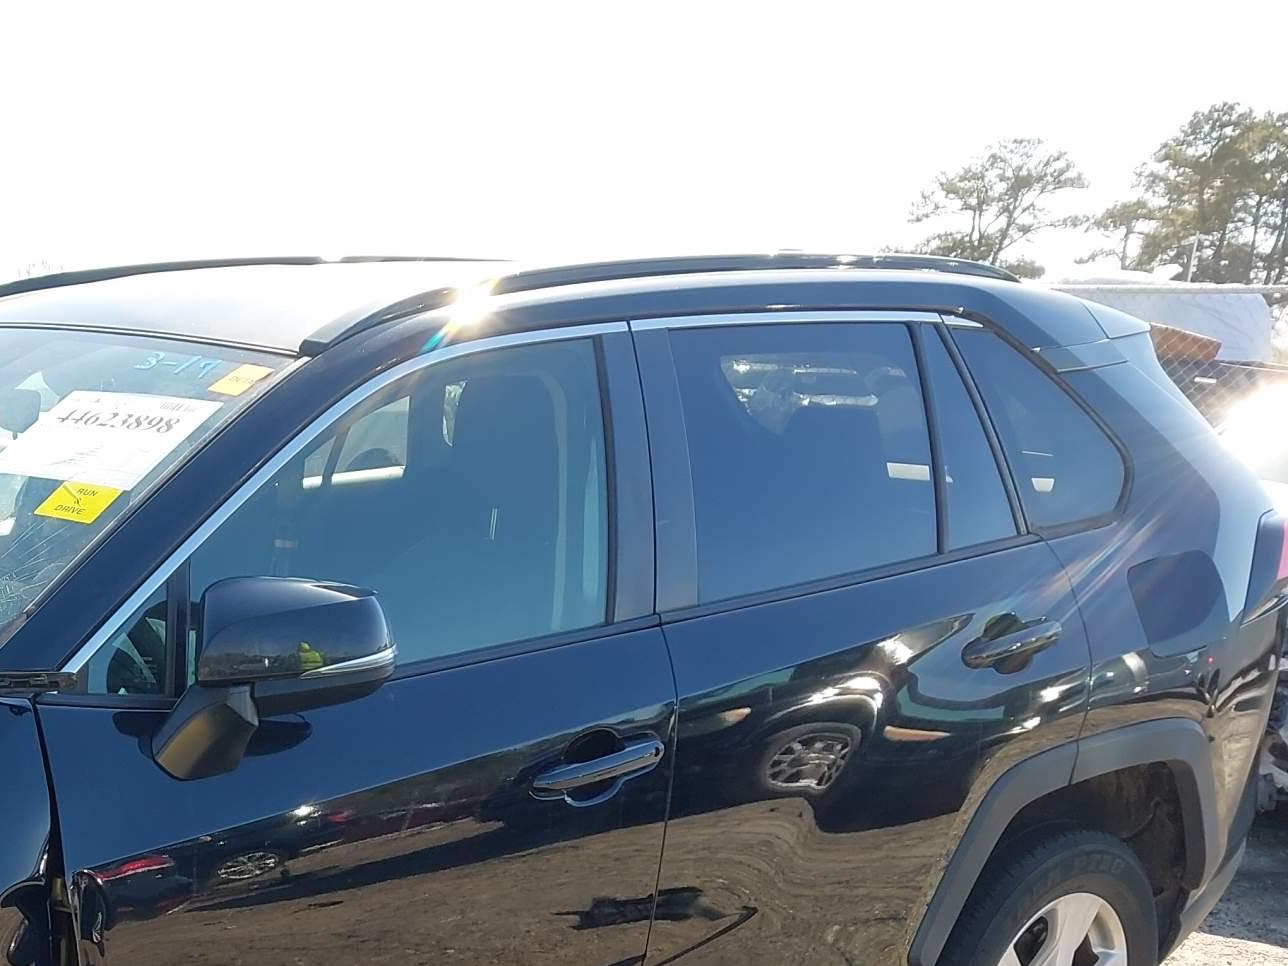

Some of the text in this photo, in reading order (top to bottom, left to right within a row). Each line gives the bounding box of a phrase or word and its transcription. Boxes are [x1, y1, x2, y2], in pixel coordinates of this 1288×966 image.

[57, 409, 180, 434] 44623898
[76, 487, 98, 497] RUN
[54, 504, 86, 515] DRIVE
